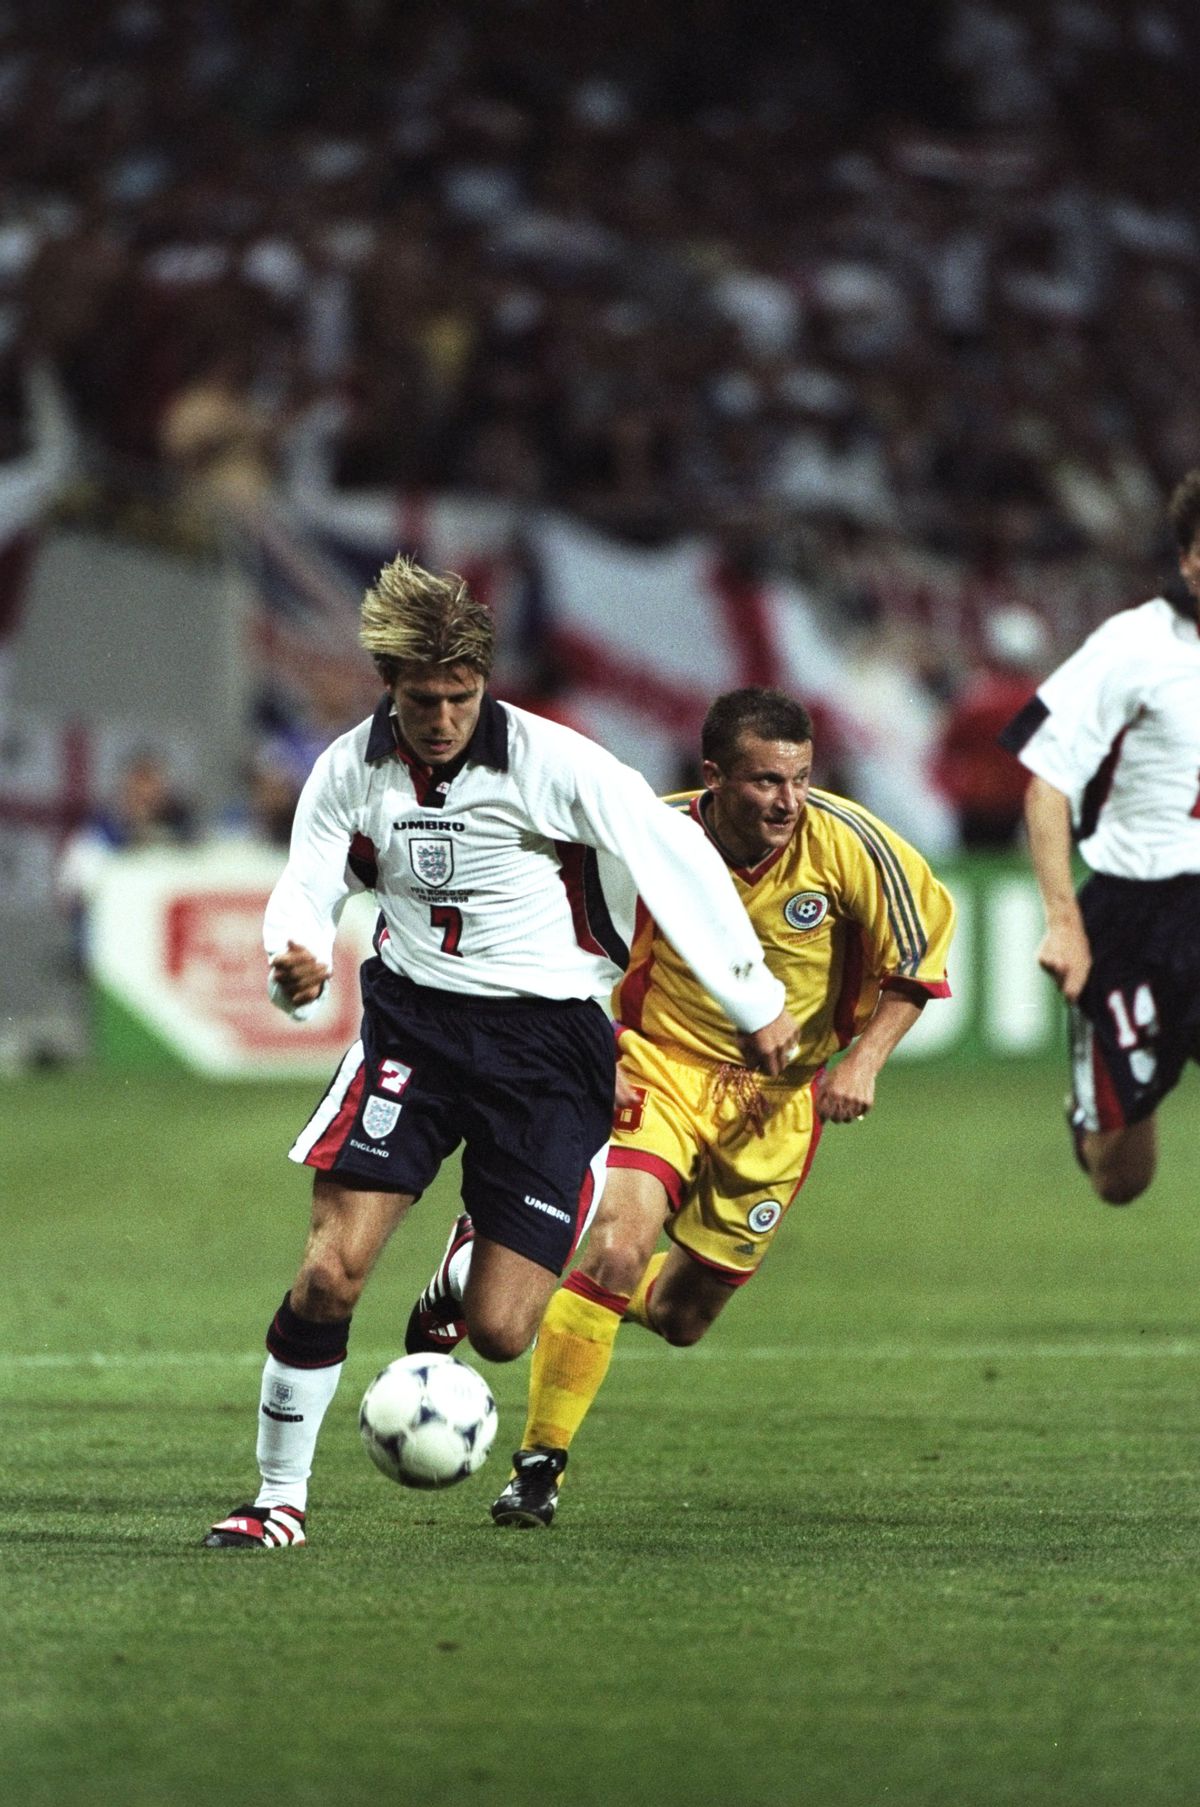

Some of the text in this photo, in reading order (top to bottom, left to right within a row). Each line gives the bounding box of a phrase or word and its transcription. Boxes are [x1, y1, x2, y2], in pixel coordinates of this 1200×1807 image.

[393, 820, 465, 832] UMBRO
[430, 904, 463, 958] 7
[350, 1139, 389, 1158] ENGLAND
[524, 1195, 571, 1224] UMBRO
